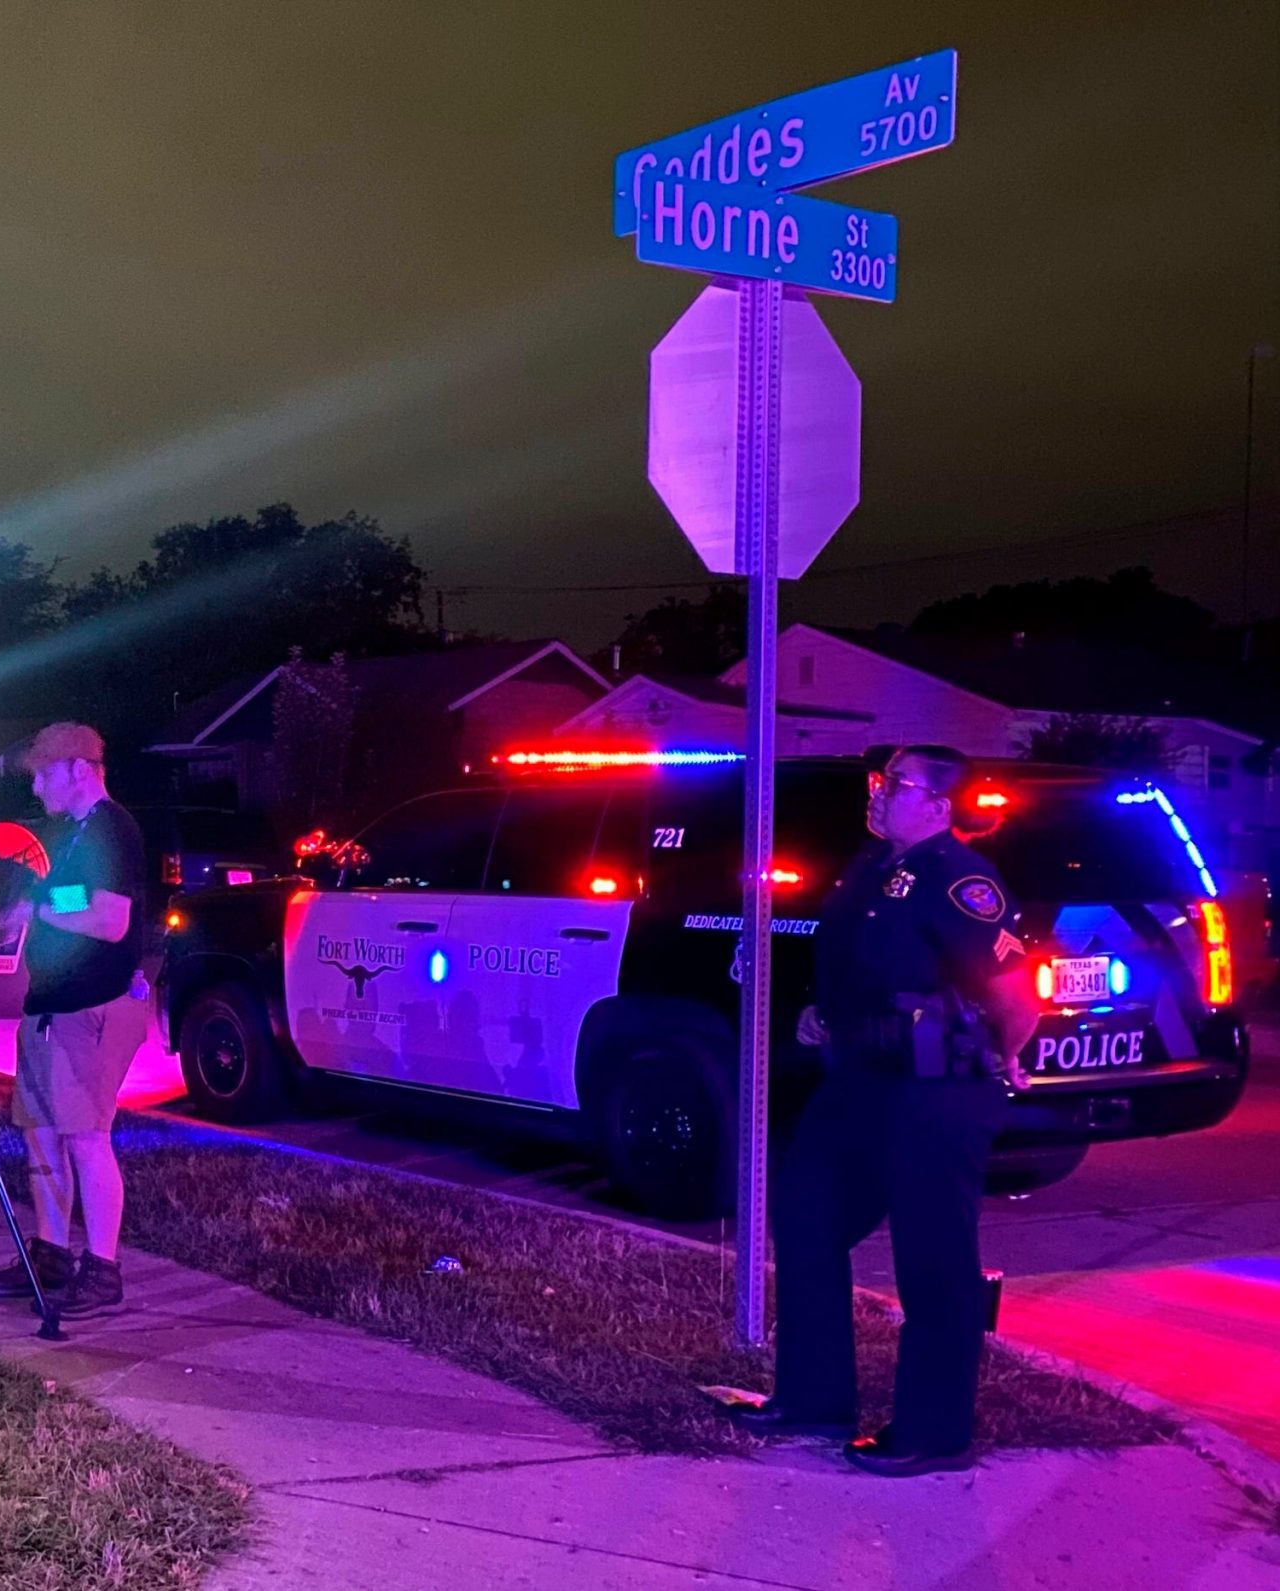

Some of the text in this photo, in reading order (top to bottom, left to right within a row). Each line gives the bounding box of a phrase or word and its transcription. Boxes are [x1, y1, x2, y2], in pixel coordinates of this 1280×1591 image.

[884, 72, 921, 107] Av
[860, 105, 938, 157] 5700
[654, 180, 799, 264] Horne
[846, 214, 869, 249] St
[831, 249, 886, 290] 3300
[652, 828, 685, 848] 721
[317, 934, 405, 966] FORT WORTH
[468, 944, 561, 978] POLICE
[1070, 961, 1092, 969] TEXAS
[1035, 1030, 1145, 1071] POLICE
